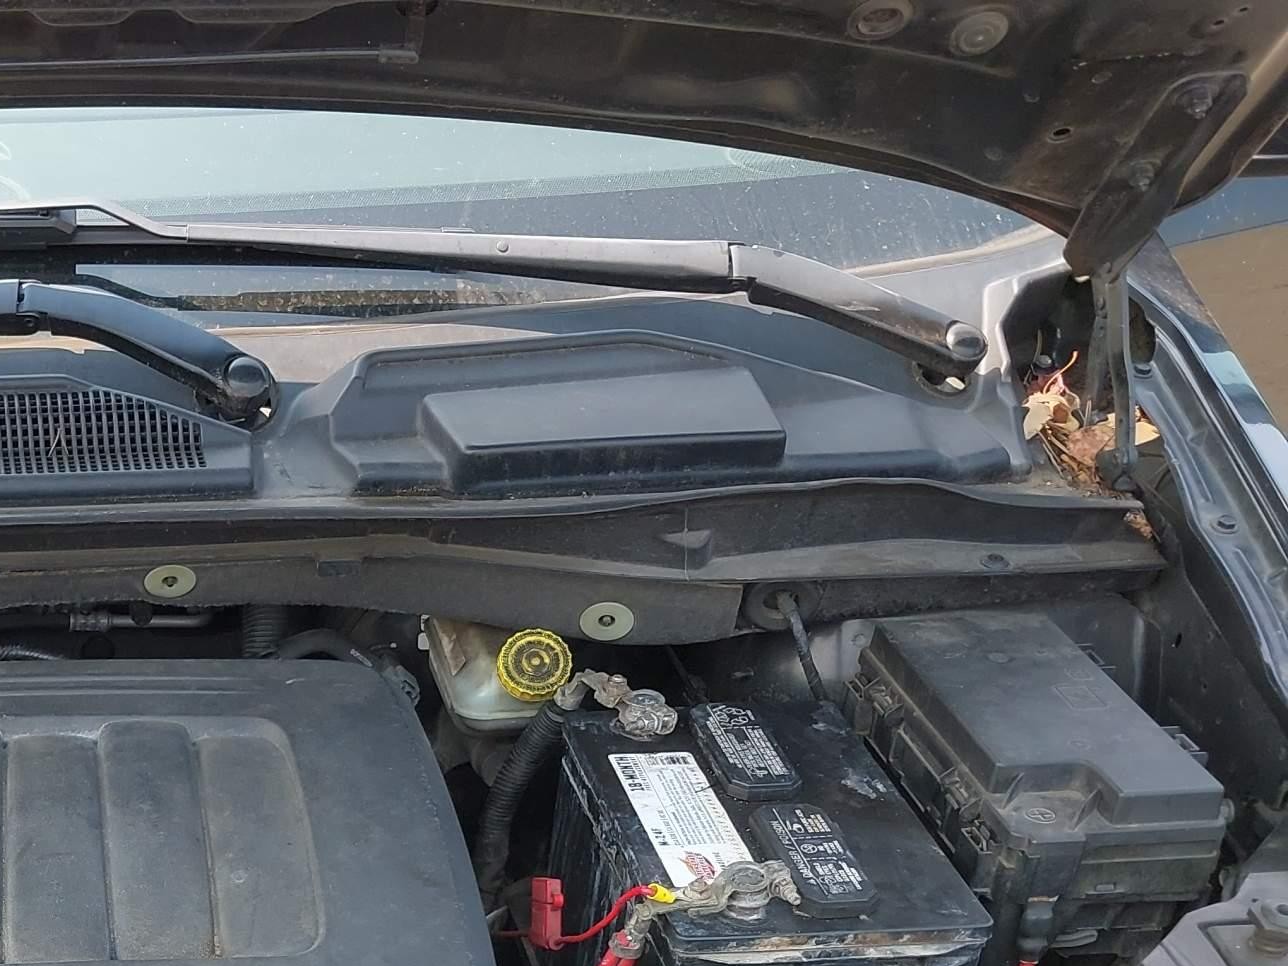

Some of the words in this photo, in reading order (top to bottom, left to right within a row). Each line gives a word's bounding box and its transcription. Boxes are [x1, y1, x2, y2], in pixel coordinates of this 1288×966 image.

[614, 756, 646, 792] 18-MONTH
[769, 819, 792, 844] POISON
[787, 850, 813, 878] DANGER
